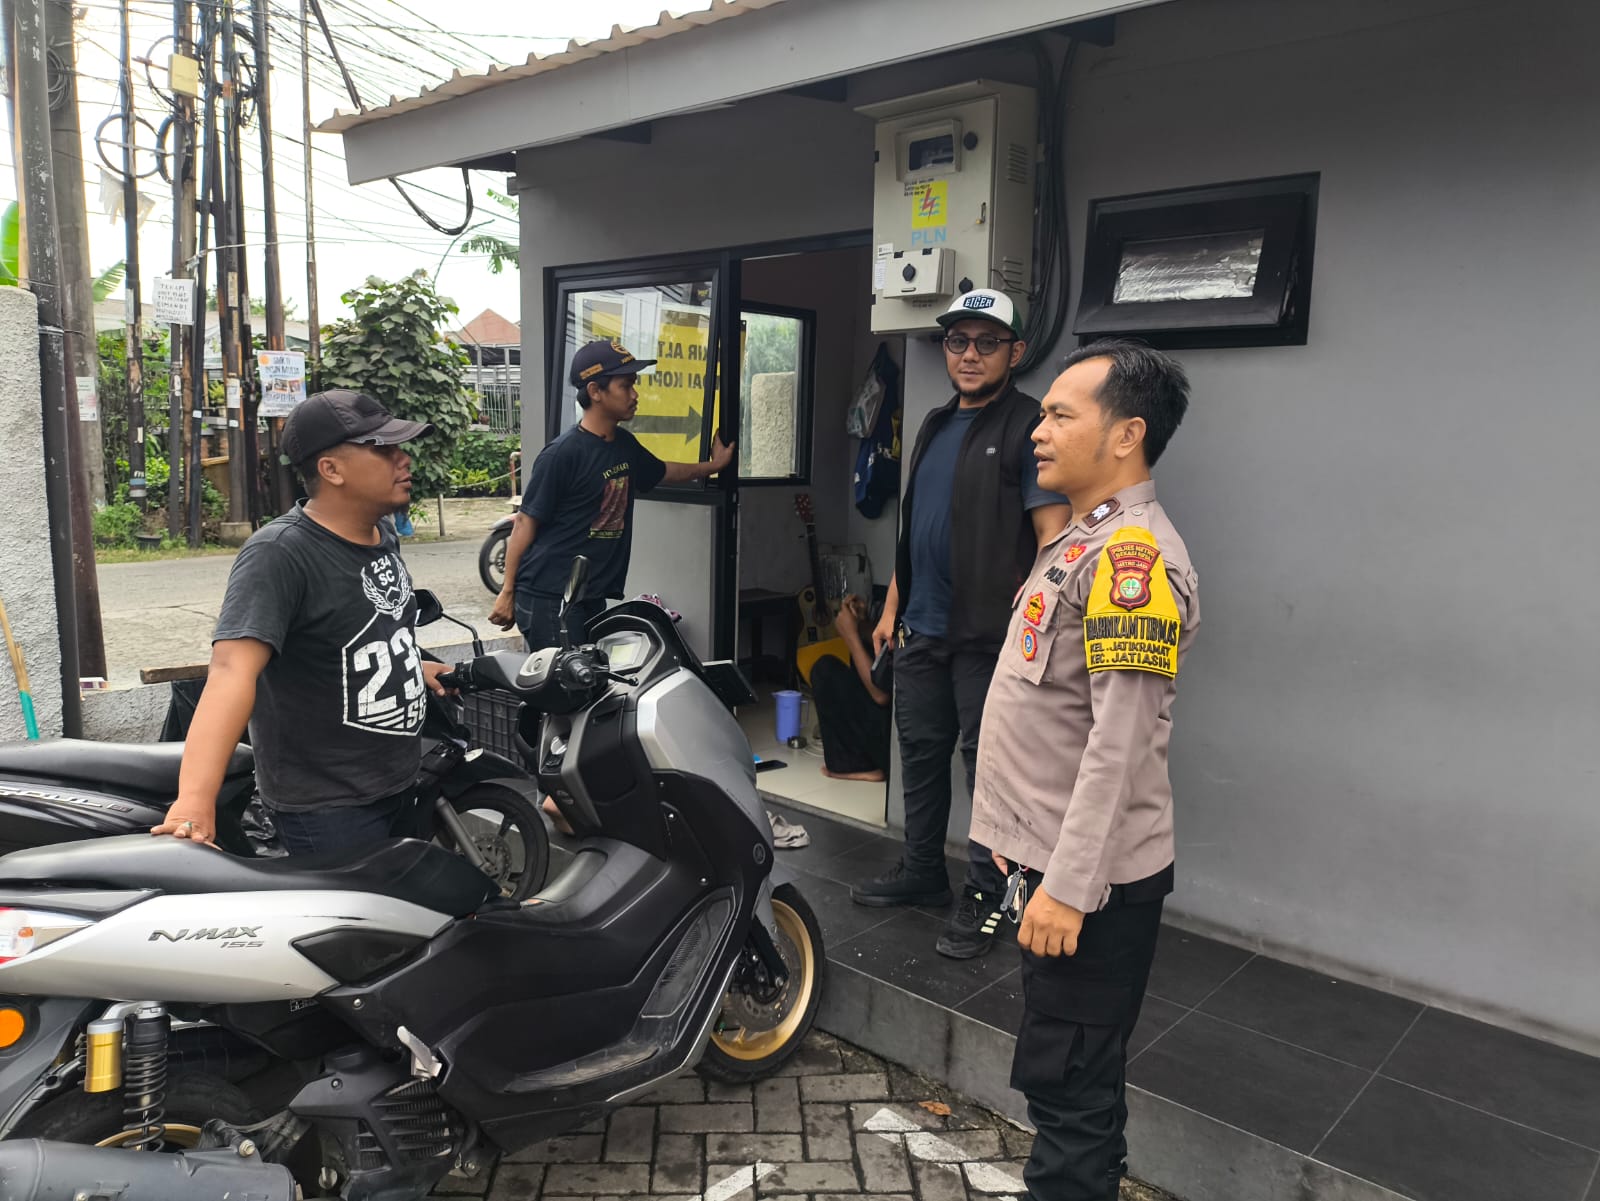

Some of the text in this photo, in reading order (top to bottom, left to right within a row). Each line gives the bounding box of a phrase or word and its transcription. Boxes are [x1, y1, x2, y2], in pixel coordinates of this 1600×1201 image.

[911, 228, 947, 246] PLN
[964, 296, 993, 308] EIGER
[371, 555, 392, 574] 234
[378, 569, 395, 586] SC
[1111, 652, 1171, 670] JATIASIH
[353, 627, 426, 718] 23
[220, 940, 265, 949] 155
